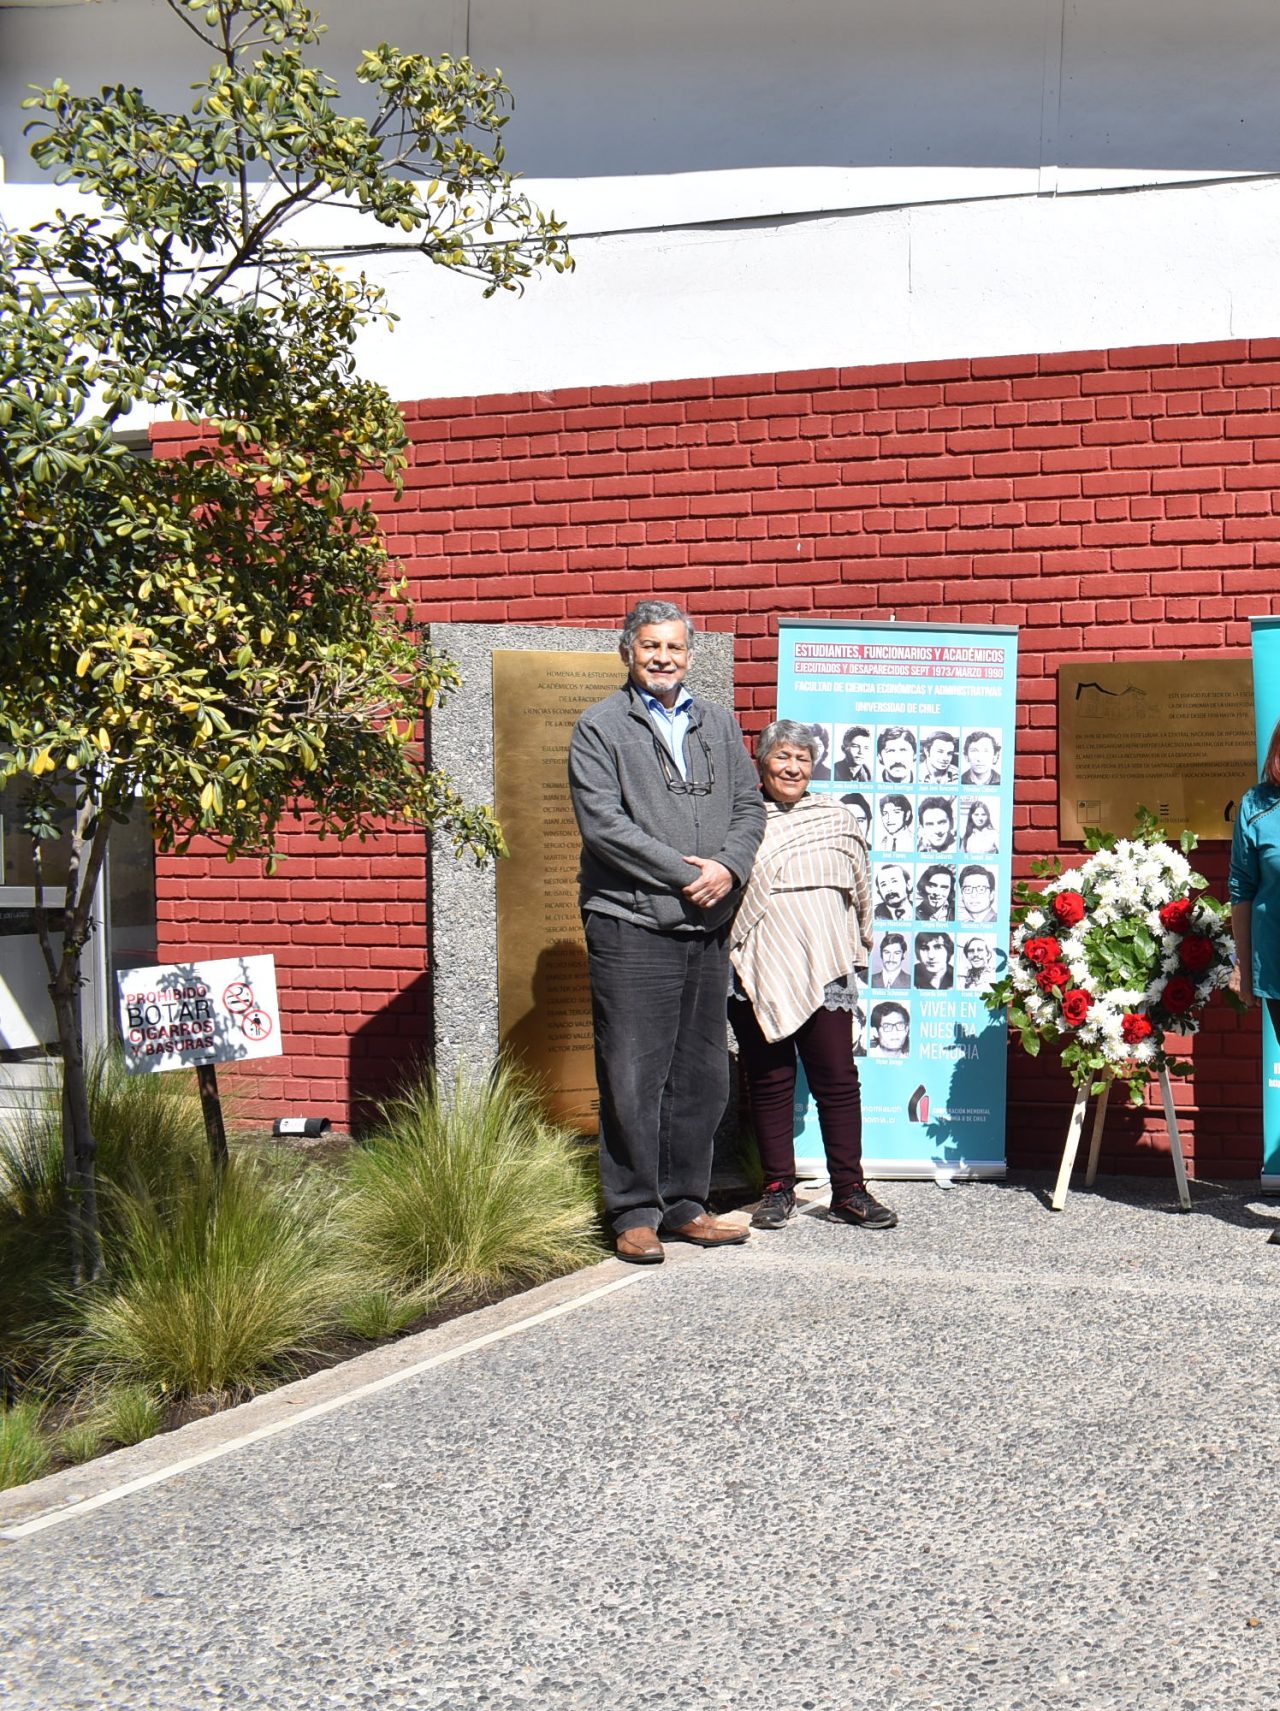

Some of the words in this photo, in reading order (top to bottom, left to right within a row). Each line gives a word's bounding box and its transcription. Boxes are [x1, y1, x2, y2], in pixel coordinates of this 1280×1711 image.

[795, 643, 862, 659] ESTUDIANTES,
[863, 645, 933, 660] FUNCIONARIOS
[933, 647, 942, 660] Y
[942, 647, 1004, 663] ACADÉMICOS
[795, 662, 841, 673] EJECUTADOS
[842, 663, 848, 674] Y
[849, 664, 909, 676] DESAPARECIDOS
[910, 666, 930, 676] SEPT
[932, 666, 982, 677] 1973/MARZO
[984, 667, 1004, 678] 1990
[855, 702, 905, 713] UNIVERSIDAD
[907, 703, 917, 714] DE
[918, 703, 942, 714] CHILE
[126, 984, 208, 1006] PROHIBIDO
[127, 1000, 212, 1029] BOTAR
[920, 1001, 957, 1018] VIVEN
[959, 1002, 977, 1018] EN
[129, 1020, 214, 1044] CIGARROS
[920, 1021, 977, 1039] NUESTRA
[131, 1044, 143, 1057] Y
[145, 1036, 214, 1056] BASURAS
[920, 1043, 980, 1060] MEMORIA
